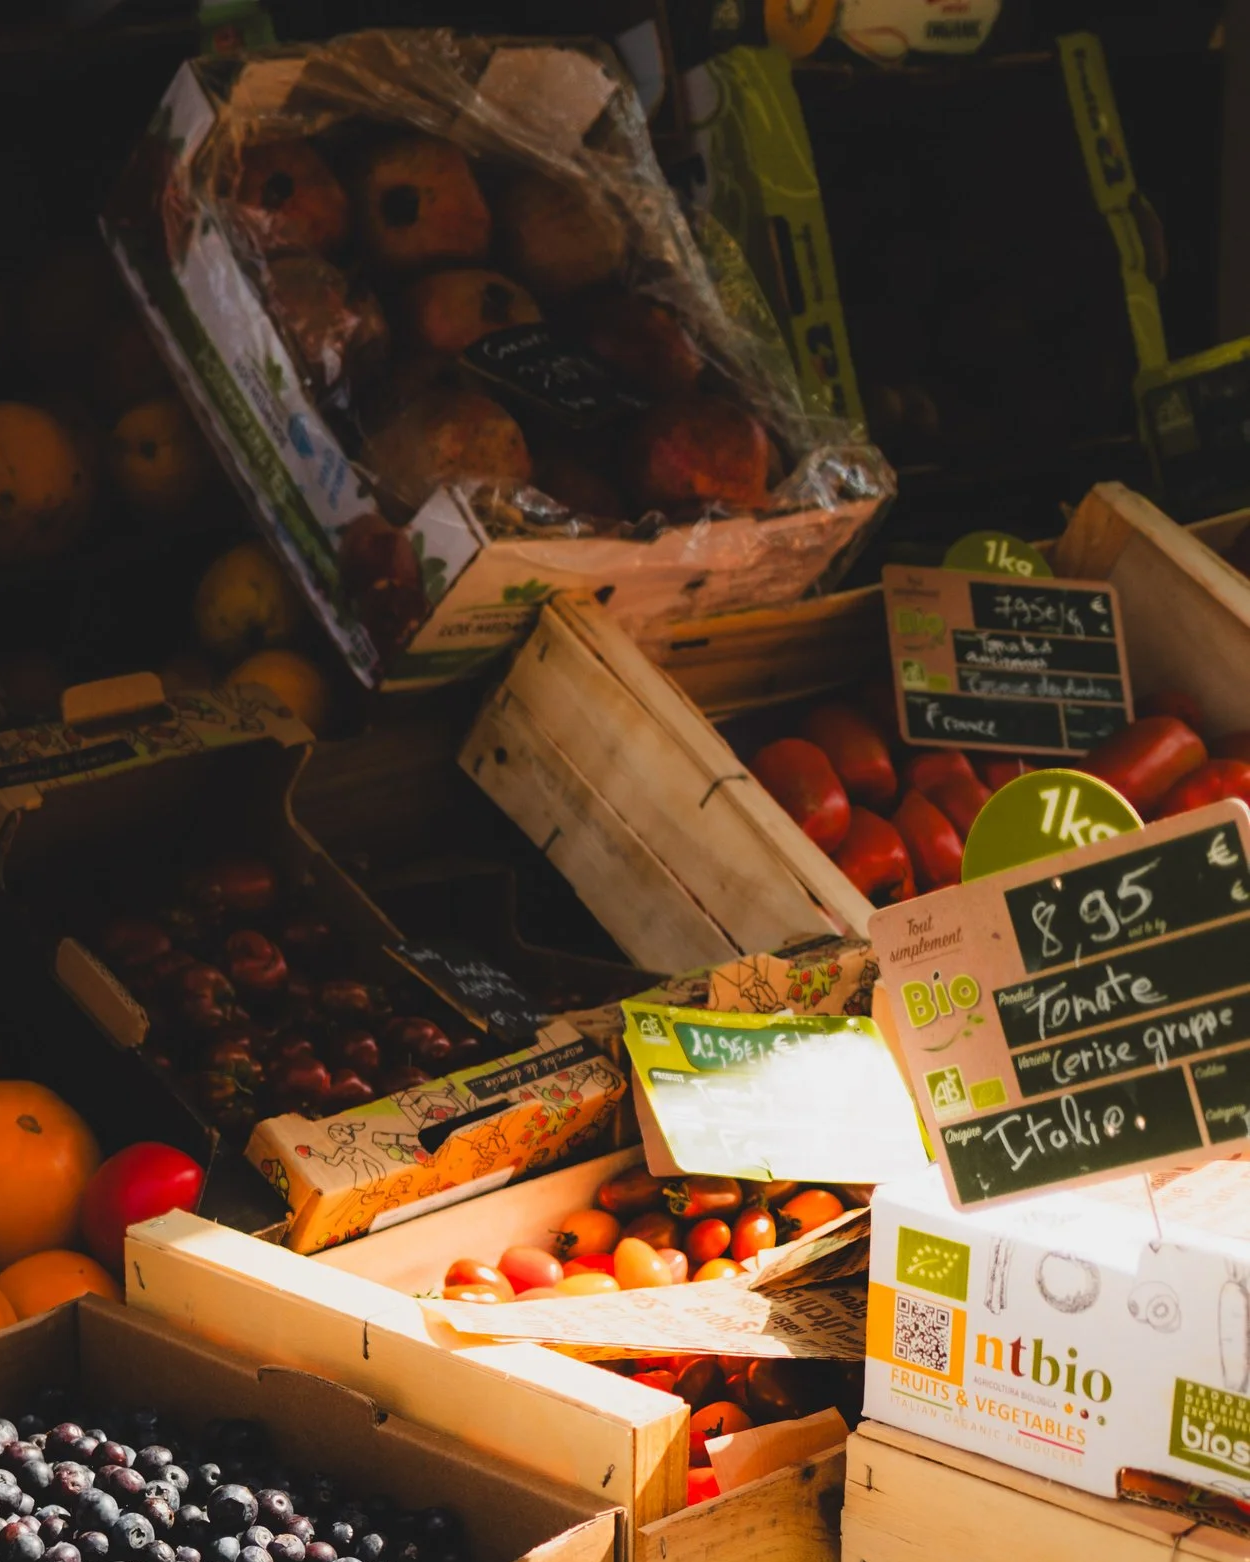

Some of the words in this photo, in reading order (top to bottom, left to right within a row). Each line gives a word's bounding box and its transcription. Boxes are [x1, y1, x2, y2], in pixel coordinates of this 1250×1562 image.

[1031, 856, 1163, 969] 8,95
[1206, 831, 1240, 868] €
[1230, 878, 1249, 902] €
[888, 928, 964, 965] simplement
[905, 914, 934, 938] Tout
[998, 985, 1036, 1006] Produit
[1024, 966, 1168, 1041] Tomate
[934, 1069, 961, 1108] AB
[944, 1123, 983, 1147] Origine
[973, 1332, 1113, 1405] ntbio
[889, 1393, 939, 1420] ITALIAN
[943, 1409, 1001, 1440] ORGANIC
[1006, 1431, 1084, 1469] PRODUCERS
[890, 1366, 951, 1402] FRUITS
[954, 1388, 971, 1410] &
[974, 1392, 1087, 1447] VEGETABLES
